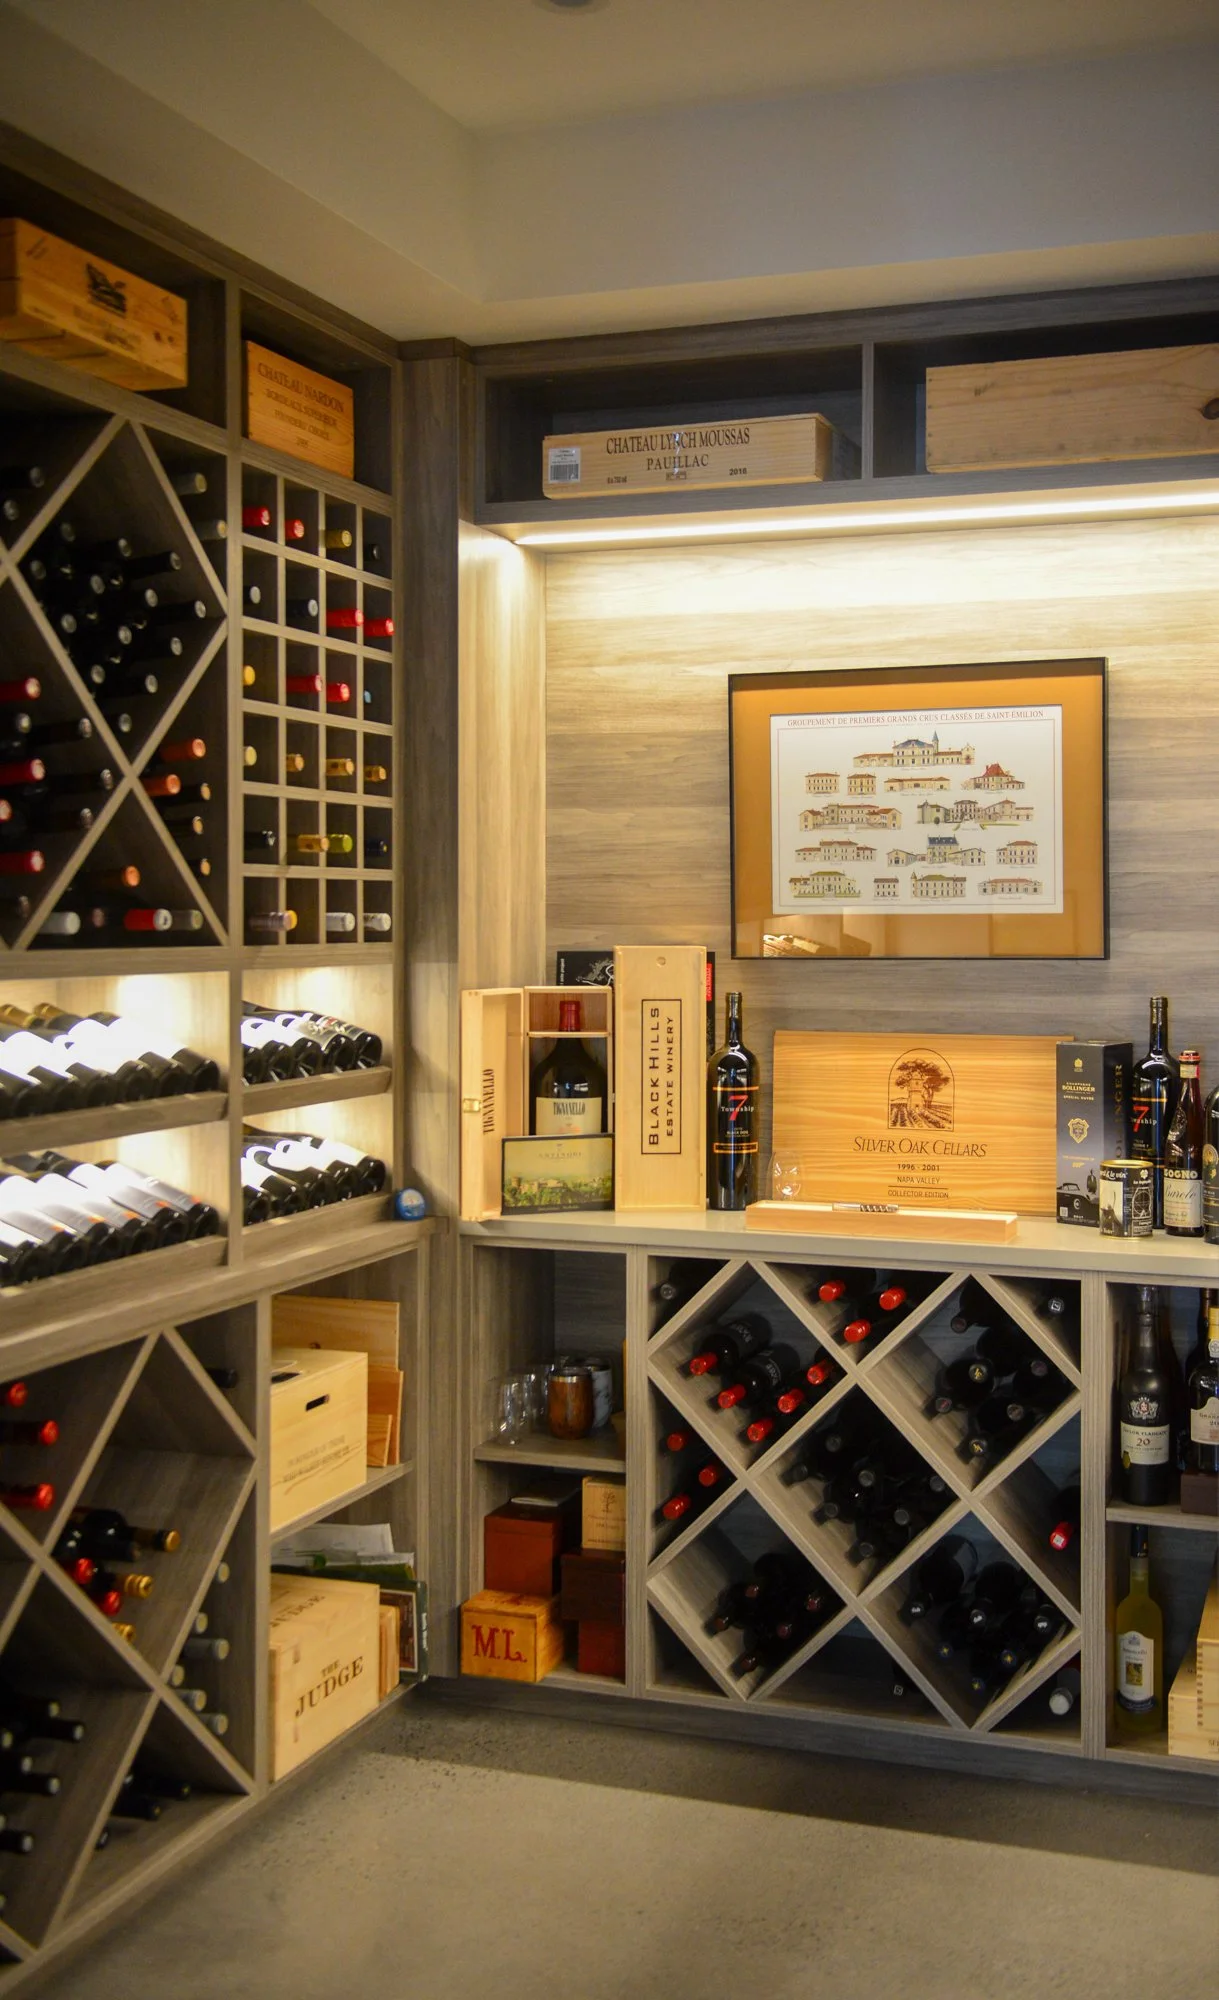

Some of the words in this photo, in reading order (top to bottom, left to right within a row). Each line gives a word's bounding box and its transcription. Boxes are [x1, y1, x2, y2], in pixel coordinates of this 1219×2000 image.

[258, 362, 304, 395] CHATEAU
[606, 435, 657, 454] CHATEAU
[660, 431, 697, 450] LYNCH
[699, 427, 751, 447] MOUSSAS
[646, 454, 709, 471] PAUILLAC
[788, 718, 835, 727] GROUPEMENT
[849, 715, 885, 724] PREMIERS
[887, 714, 917, 723] GRANDS
[919, 713, 939, 722] CRUS
[975, 711, 985, 720] DE
[649, 1007, 660, 1070] HILLS
[483, 1069, 495, 1135] TIGNANELLO
[553, 1102, 586, 1115] TIGNANELLO
[649, 1077, 659, 1145] BLACK
[728, 1095, 748, 1121] 7
[1133, 1105, 1149, 1132] 7
[853, 1136, 896, 1154] SILVER
[898, 1138, 930, 1155] OAK
[932, 1140, 988, 1158] CELLARS
[897, 1176, 915, 1184] NAPA
[916, 1177, 940, 1185] VALLEY
[888, 1189, 923, 1198] COLLECTOR
[924, 1190, 949, 1199] EDITION
[1136, 1437, 1151, 1447] 20
[321, 1659, 339, 1678] THE
[295, 1656, 363, 1717] JUDGE
